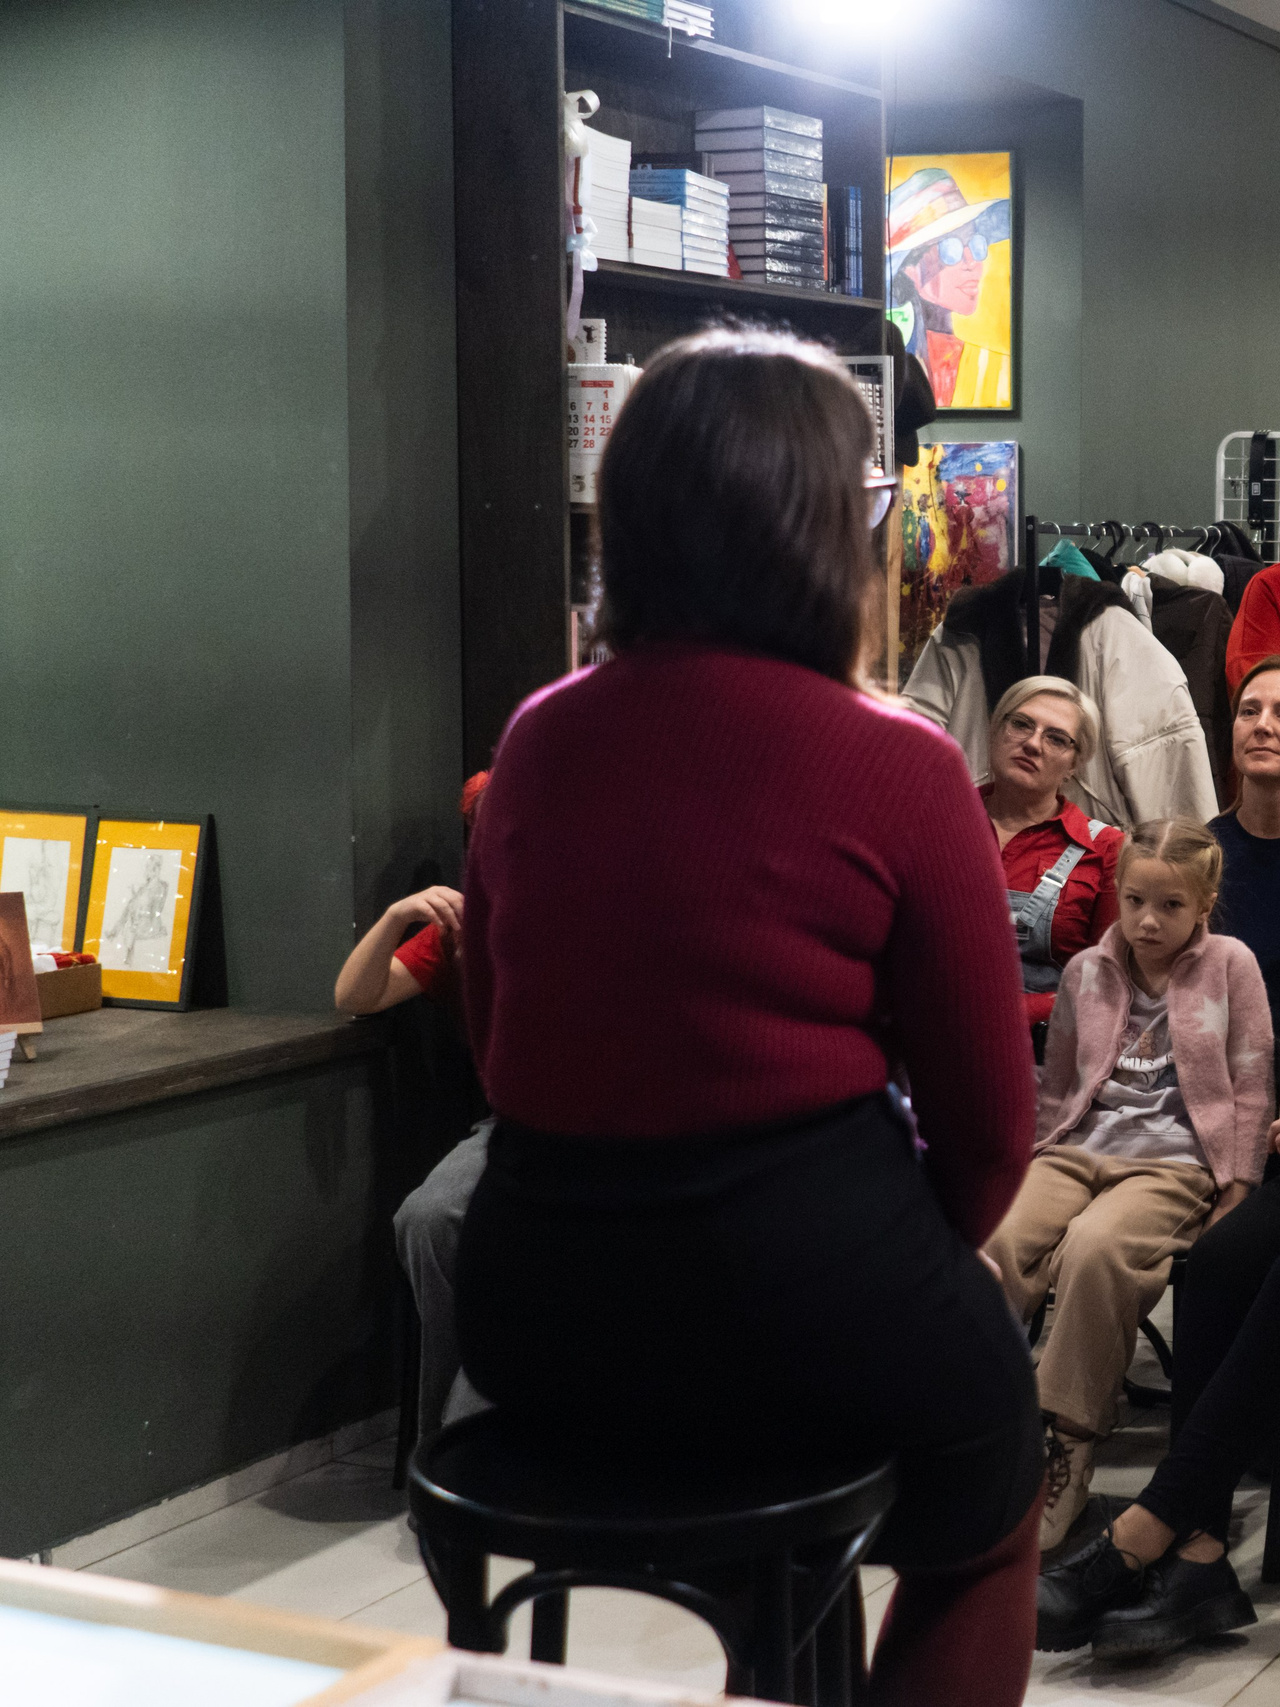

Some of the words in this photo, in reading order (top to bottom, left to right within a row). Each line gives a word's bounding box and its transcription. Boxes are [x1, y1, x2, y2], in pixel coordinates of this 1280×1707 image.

[603, 389, 608, 399] 1
[570, 402, 577, 411] 6
[586, 402, 593, 411] 7
[603, 402, 609, 411] 8
[568, 414, 579, 424] 13
[583, 414, 595, 423] 14
[600, 414, 612, 424] 15
[568, 427, 579, 436] 20
[584, 427, 595, 436] 21
[599, 427, 612, 437] 22
[568, 439, 579, 449] 27
[583, 439, 595, 449] 28
